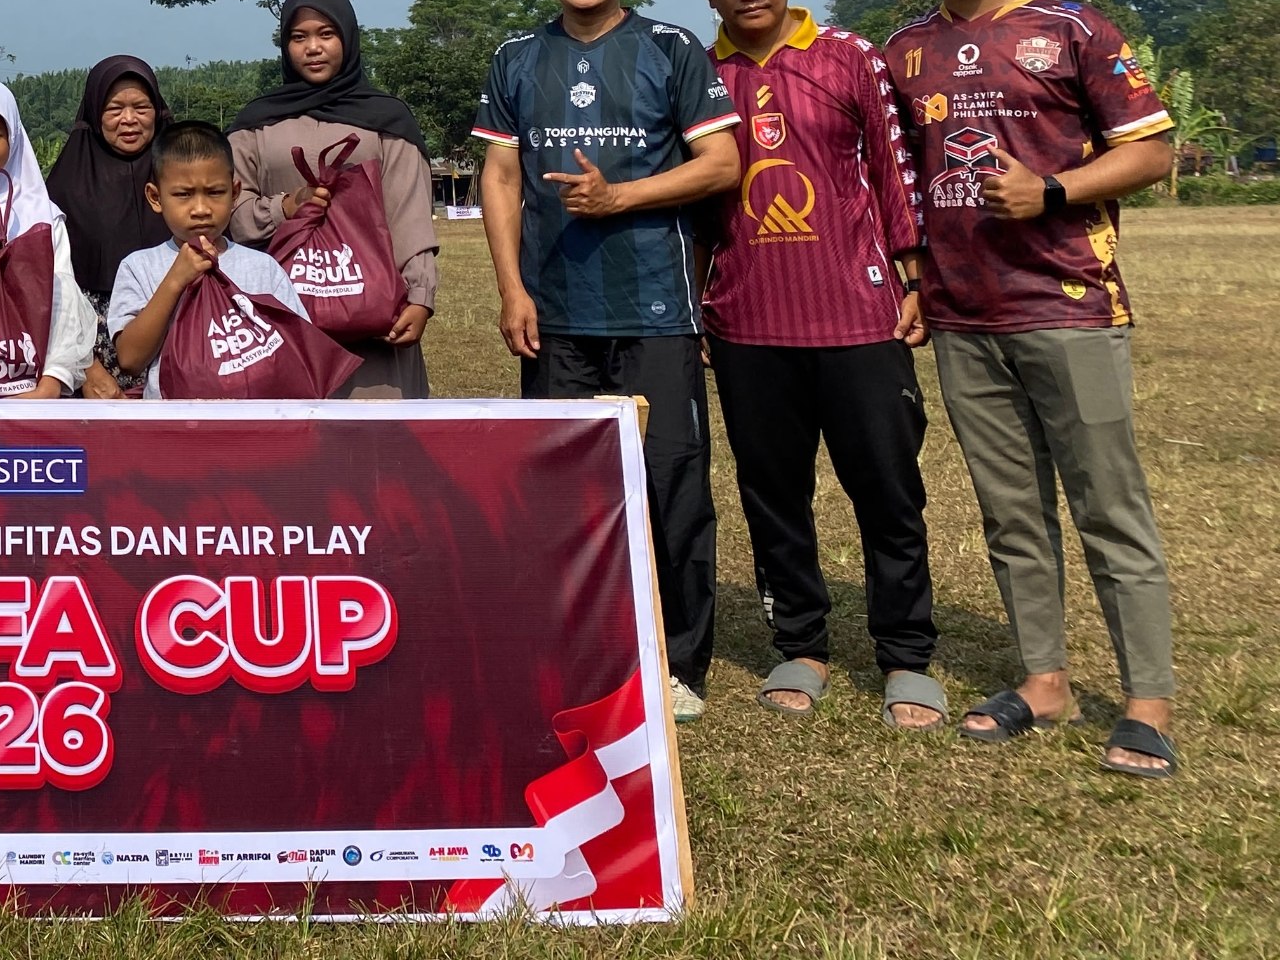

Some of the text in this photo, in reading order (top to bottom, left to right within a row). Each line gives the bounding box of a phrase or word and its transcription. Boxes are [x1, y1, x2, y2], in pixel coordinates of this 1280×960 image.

[905, 47, 923, 78] 11
[953, 92, 1004, 101] AS-SYIFA
[953, 101, 996, 109] ISLAMIC
[953, 109, 1038, 119] PHILANTHROPY
[544, 127, 647, 138] TOKO BANGUNAN
[544, 137, 647, 148] AS-SYIFA
[933, 182, 981, 200] ASSY
[785, 235, 819, 243] MANDIRI
[293, 248, 332, 266] AKSI
[290, 263, 363, 283] PEDULI
[111, 525, 187, 556] DAN
[196, 525, 275, 555] FAIR
[284, 525, 372, 555] PLAY
[136, 574, 396, 691] CUP
[447, 846, 469, 856] JAYA
[116, 854, 150, 862] NAIRA
[221, 853, 271, 861] SIT ARRIFQI
